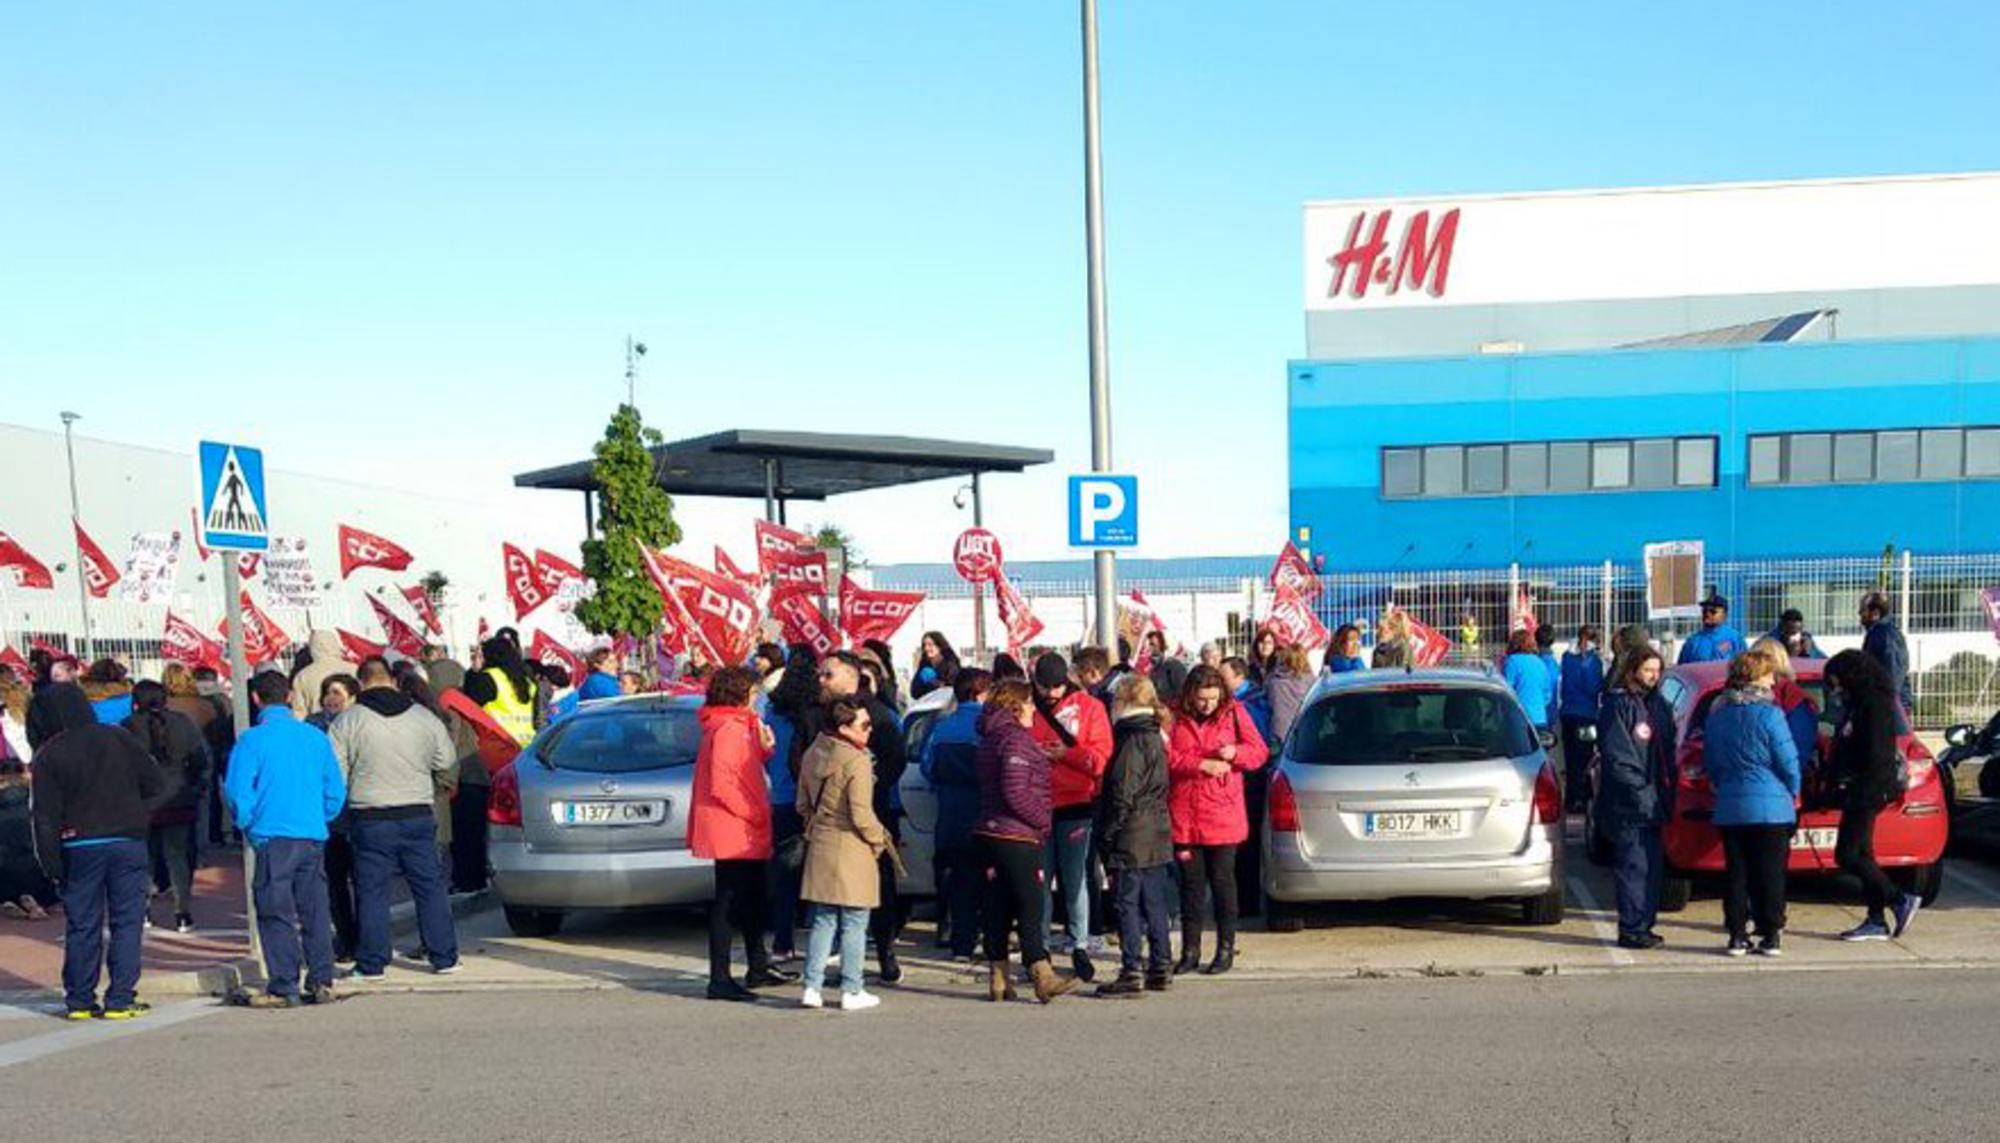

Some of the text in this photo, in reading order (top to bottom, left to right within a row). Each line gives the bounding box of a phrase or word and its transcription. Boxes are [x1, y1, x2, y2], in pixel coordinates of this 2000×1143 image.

[1328, 208, 1460, 298] H&M
[1080, 481, 1125, 542] P
[1377, 814, 1453, 832] 8017 HKK
